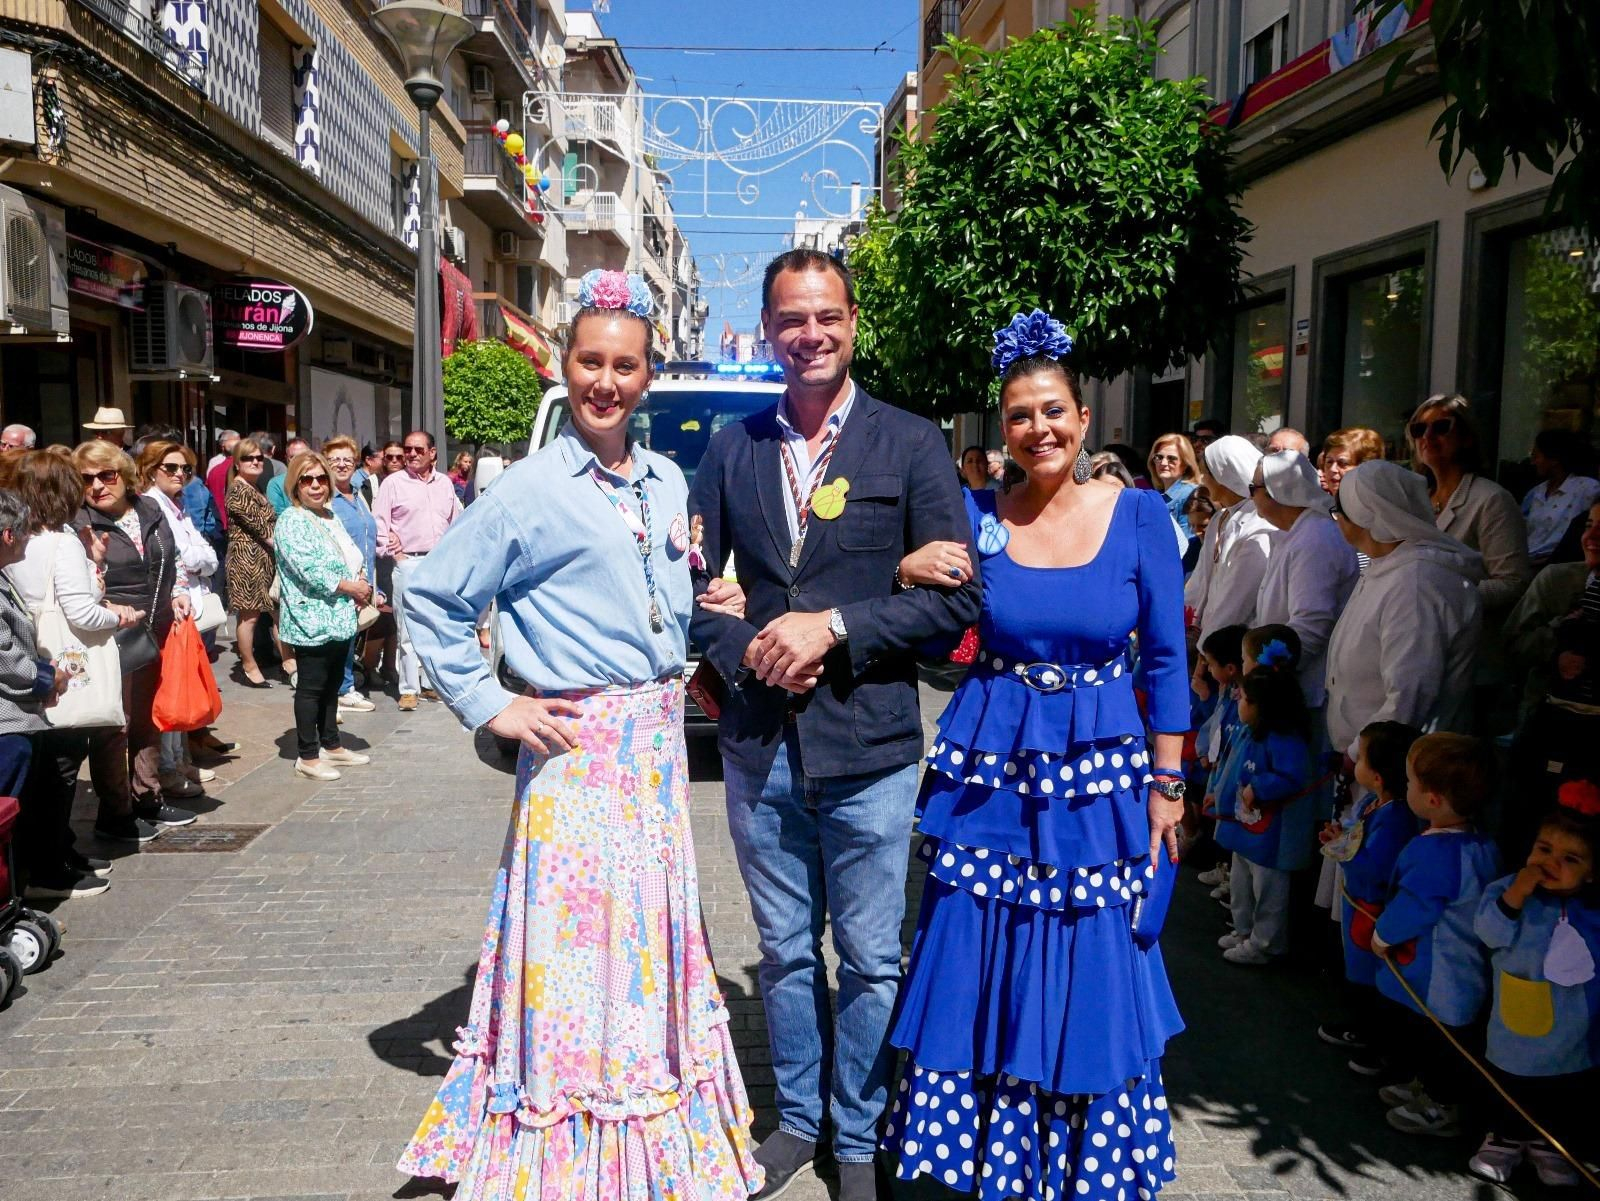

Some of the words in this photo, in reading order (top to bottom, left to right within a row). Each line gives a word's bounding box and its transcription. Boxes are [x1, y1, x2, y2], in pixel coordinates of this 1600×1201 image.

[214, 287, 282, 304] HELADOS
[256, 322, 268, 332] de
[269, 323, 294, 334] Jijona
